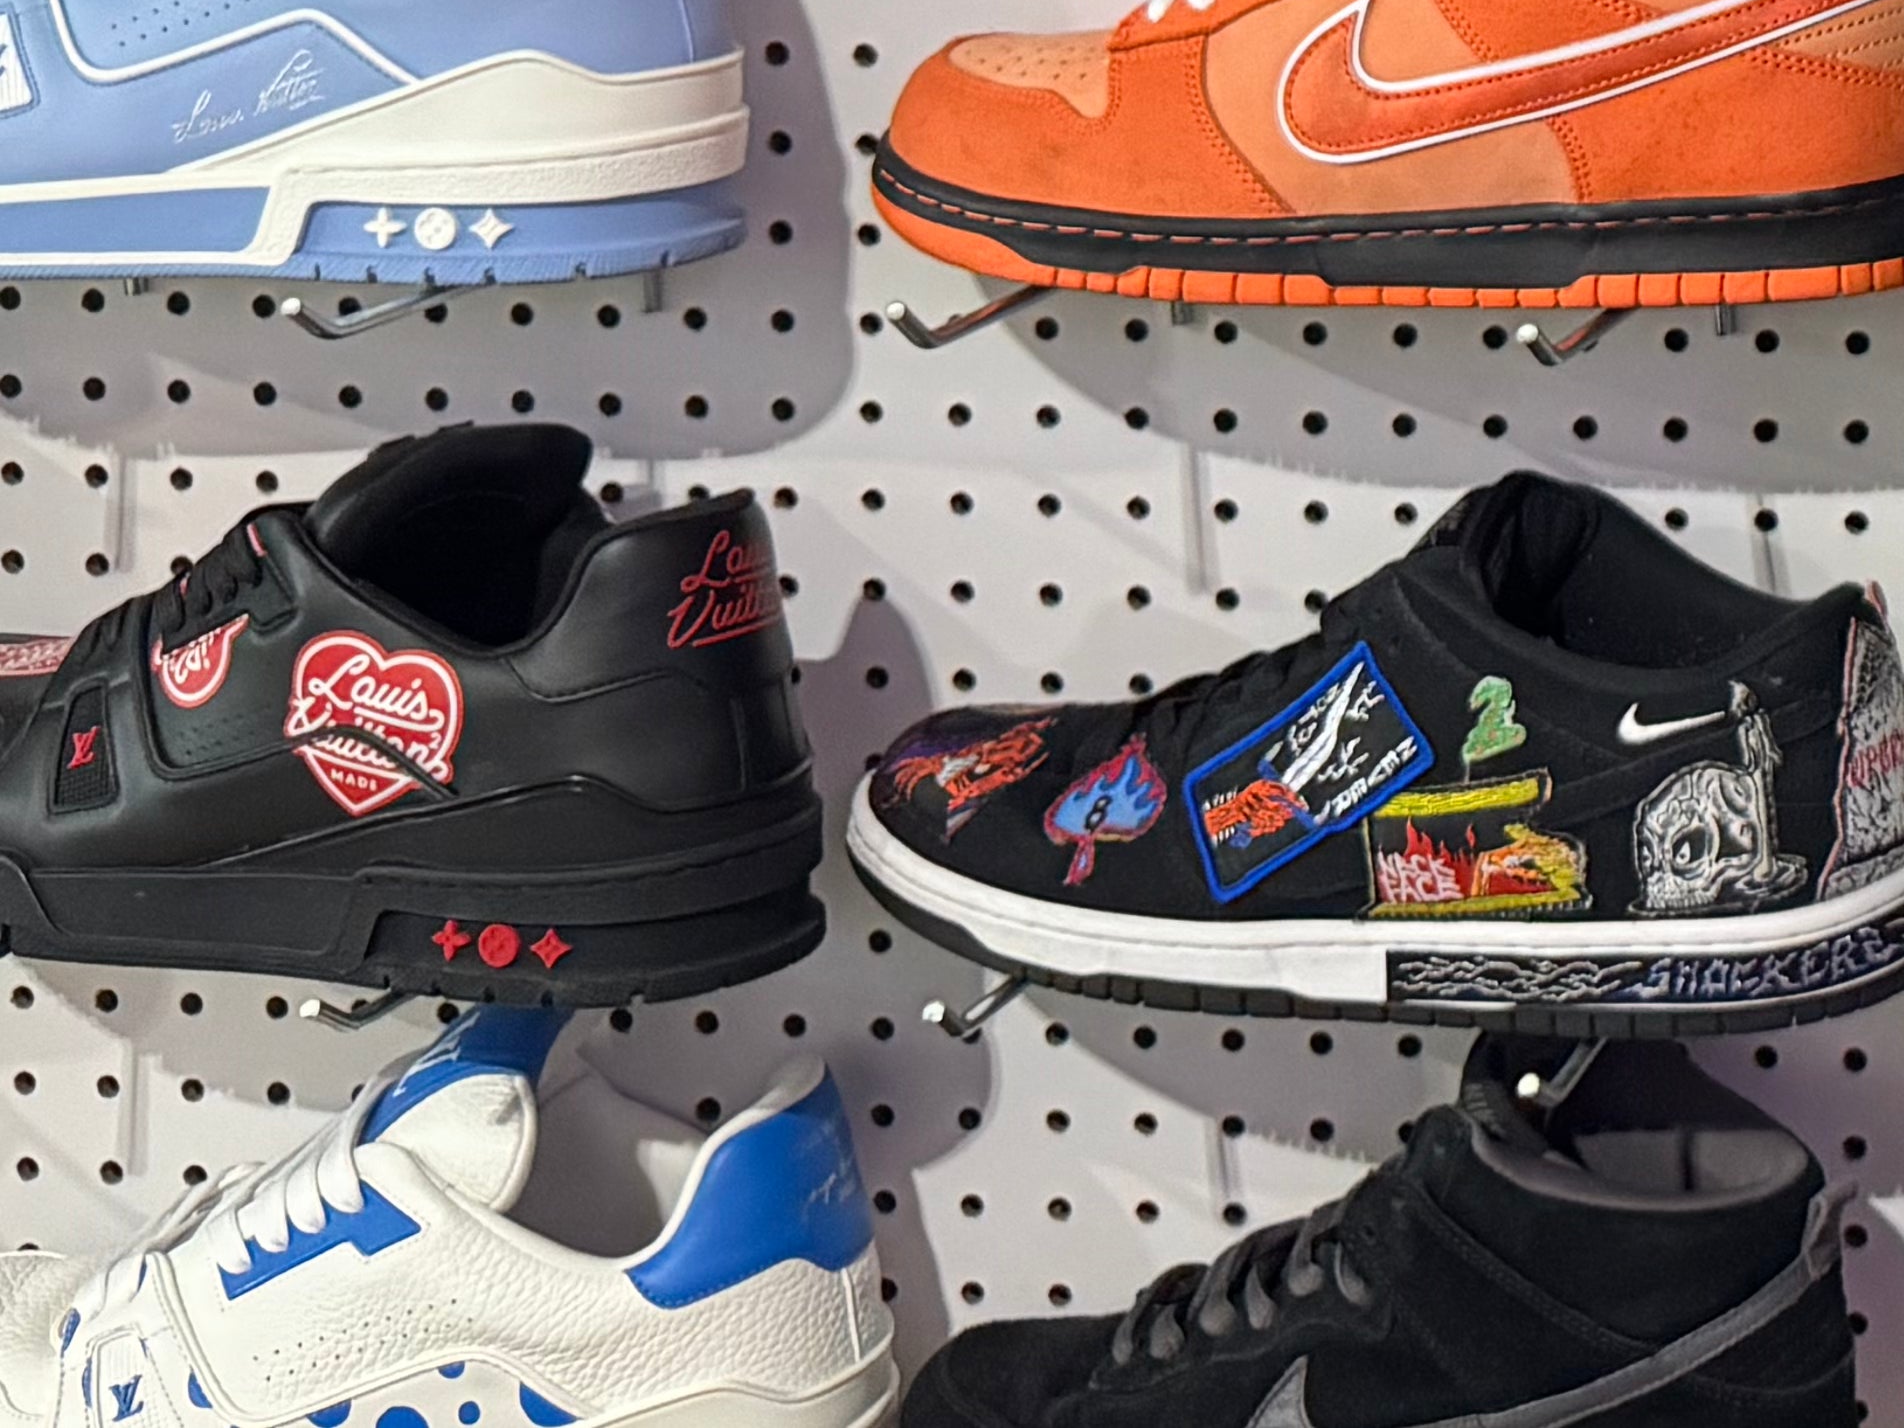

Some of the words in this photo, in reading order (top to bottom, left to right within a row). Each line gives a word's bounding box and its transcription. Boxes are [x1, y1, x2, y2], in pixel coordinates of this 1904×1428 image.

[309, 654, 428, 721] Louis
[331, 769, 378, 791] MADE
[109, 1374, 145, 1421] LV
